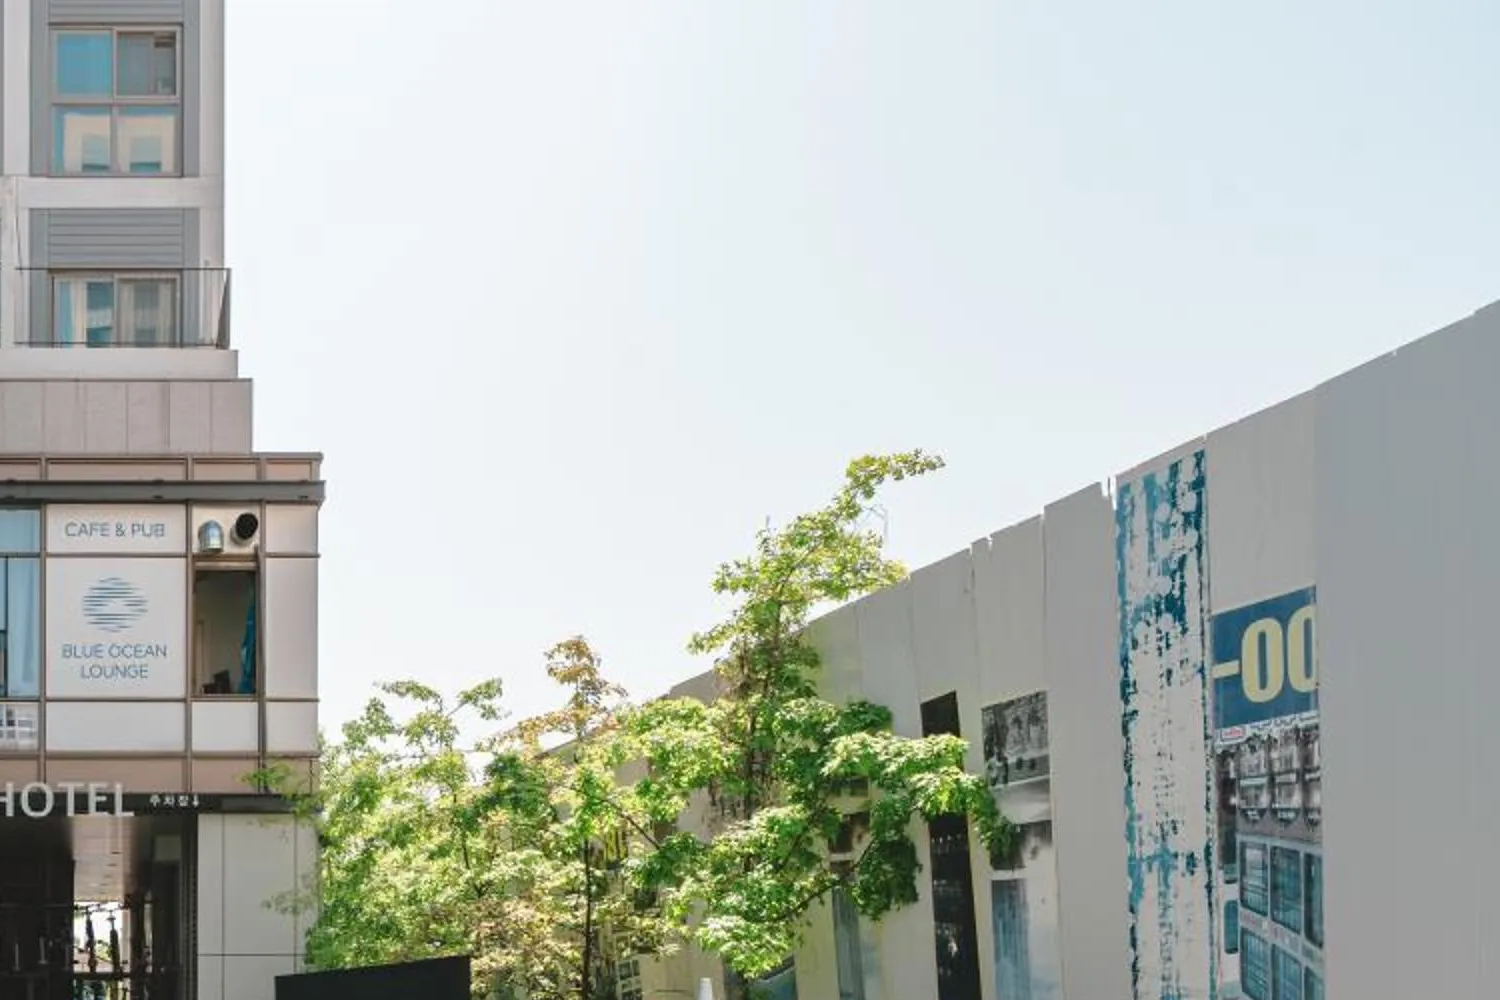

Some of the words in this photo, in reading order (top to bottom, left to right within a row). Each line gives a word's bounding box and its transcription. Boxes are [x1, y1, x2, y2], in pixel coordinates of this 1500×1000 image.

[65, 522, 110, 537] CAFE
[115, 523, 126, 537] &
[132, 523, 165, 537] PUB
[62, 644, 104, 659] BLUE
[108, 643, 168, 659] OCEAN
[81, 664, 148, 679] LOUNGE
